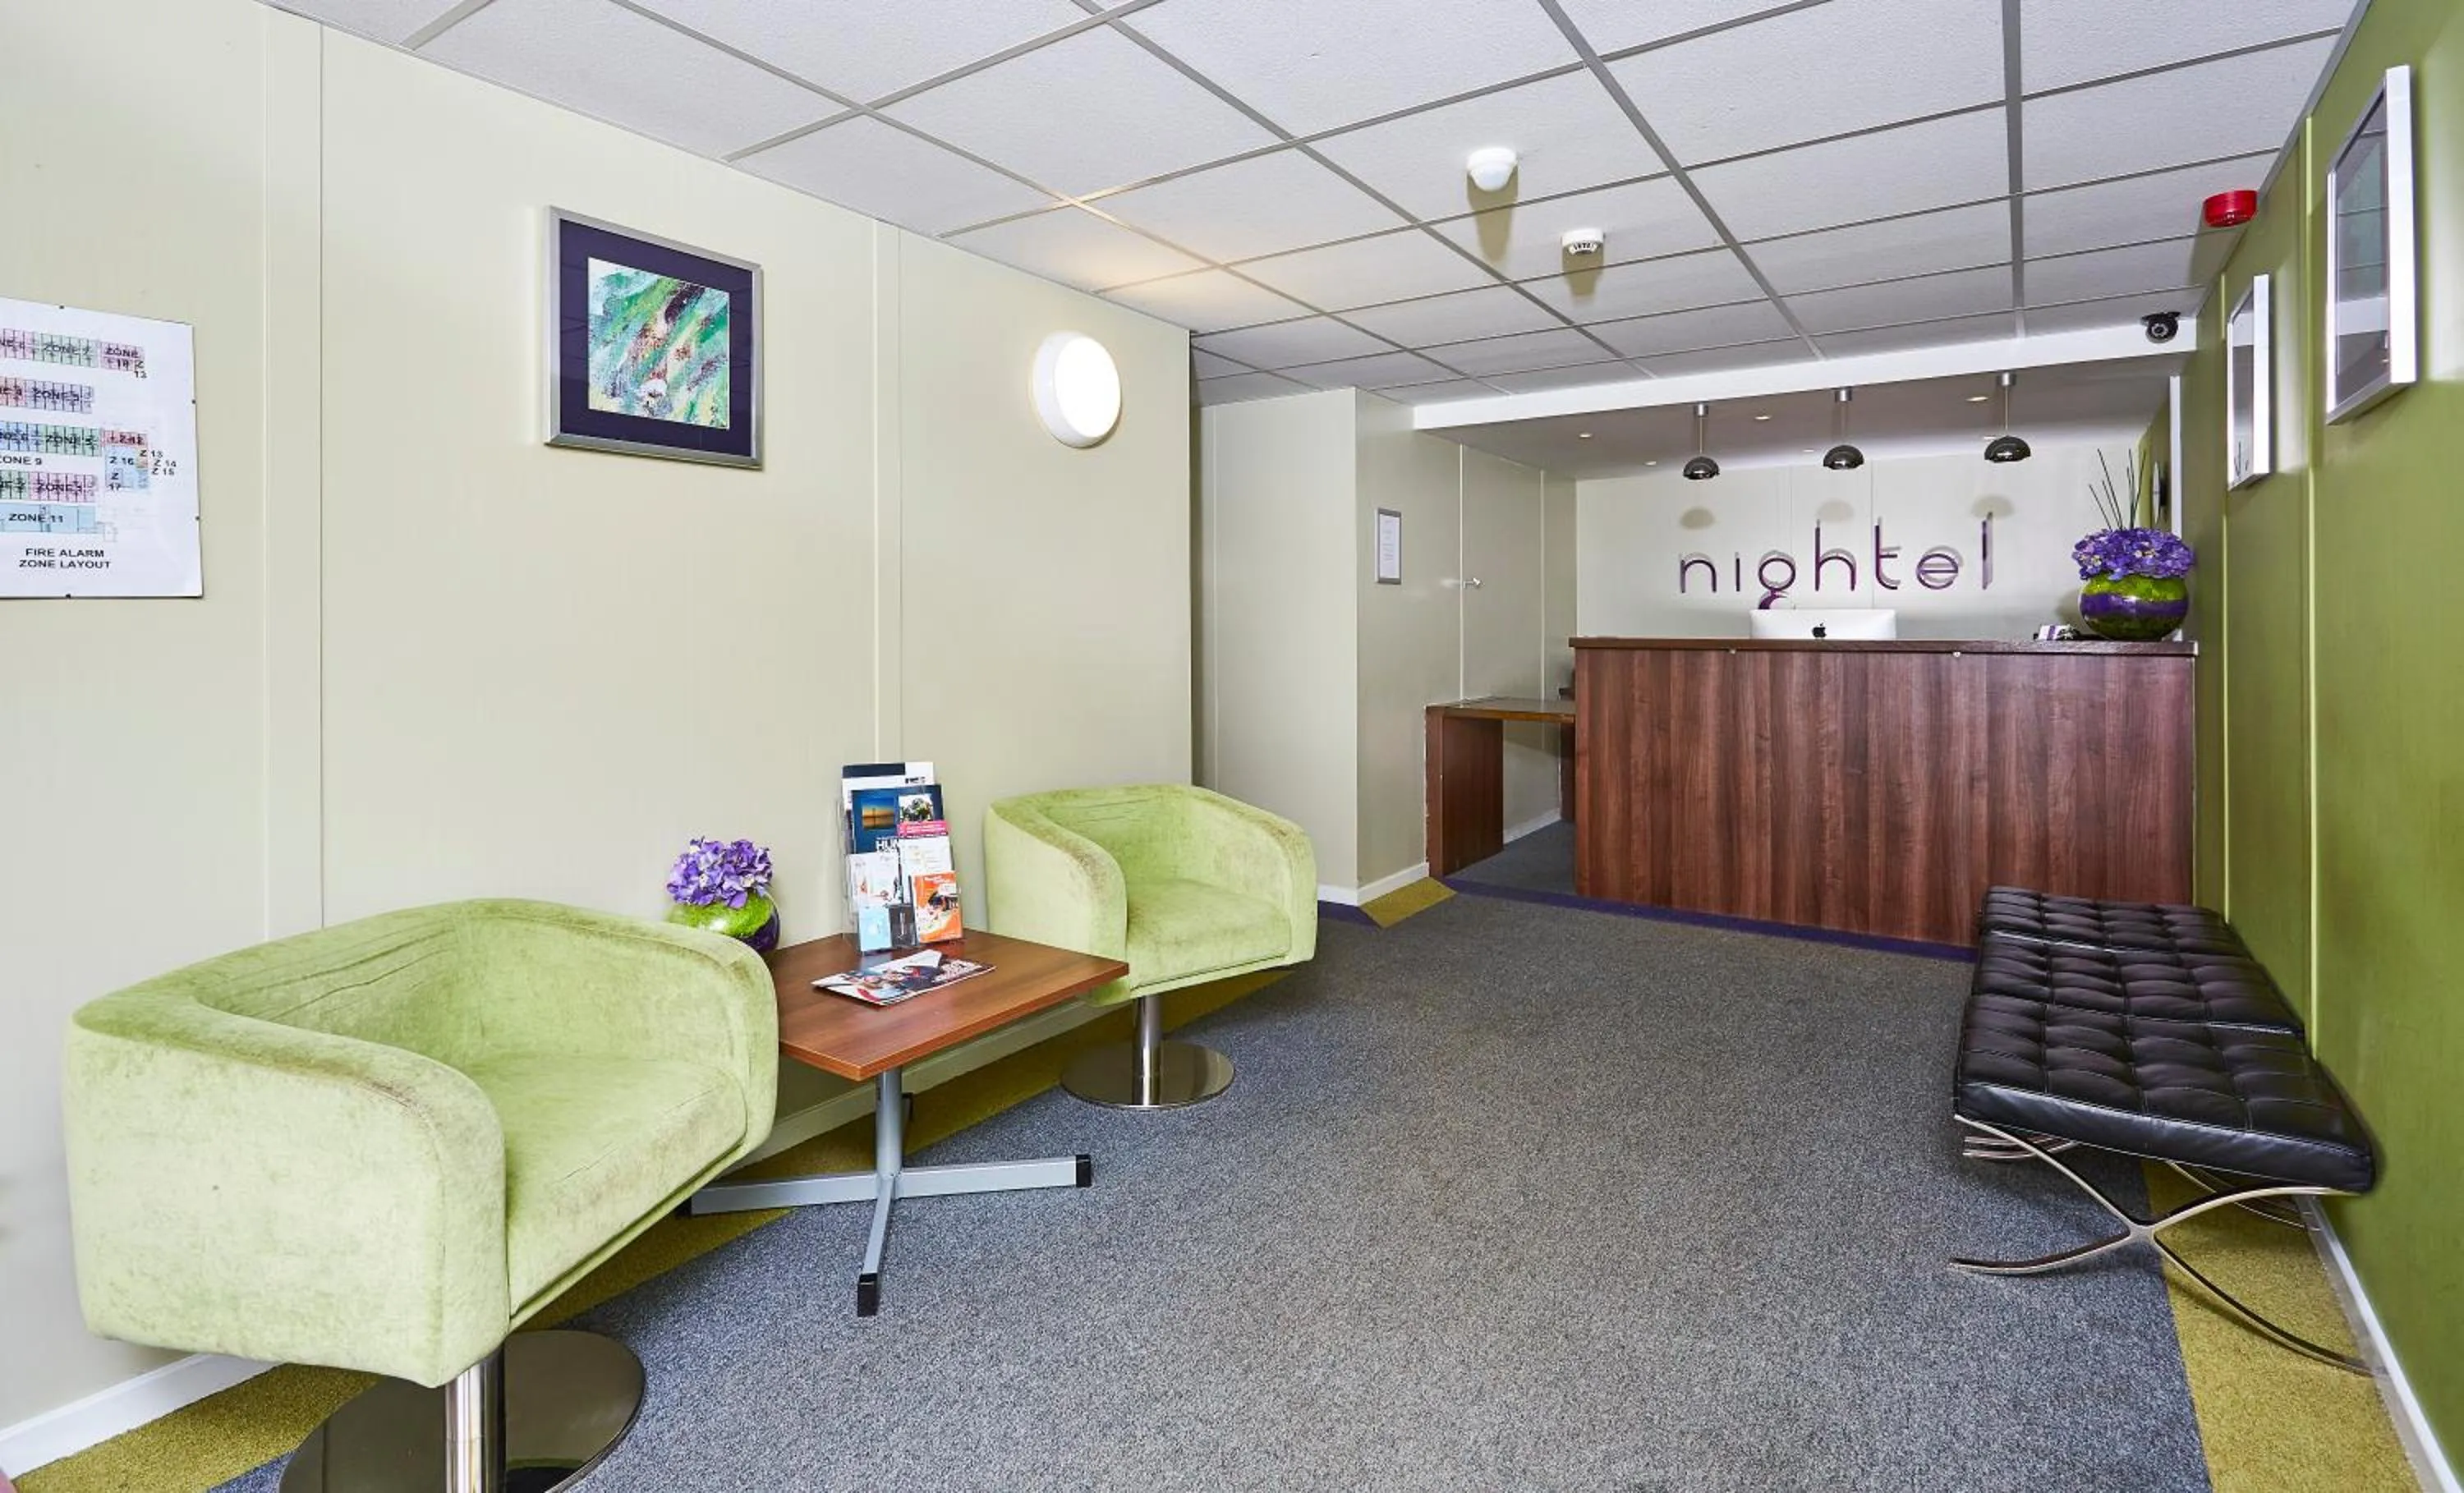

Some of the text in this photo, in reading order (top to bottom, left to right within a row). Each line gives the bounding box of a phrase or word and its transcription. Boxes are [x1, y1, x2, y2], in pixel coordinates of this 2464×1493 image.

[106, 348, 140, 359] ZONE
[140, 449, 147, 457] Z
[0, 455, 43, 466] ONE 9
[109, 456, 135, 466] Z 16
[111, 472, 119, 480] Z
[8, 513, 64, 523] ZONE 11
[25, 548, 105, 558] FIRE ALARM
[19, 559, 111, 569] ZONE LAYOUT
[1680, 517, 1992, 610] nightel
